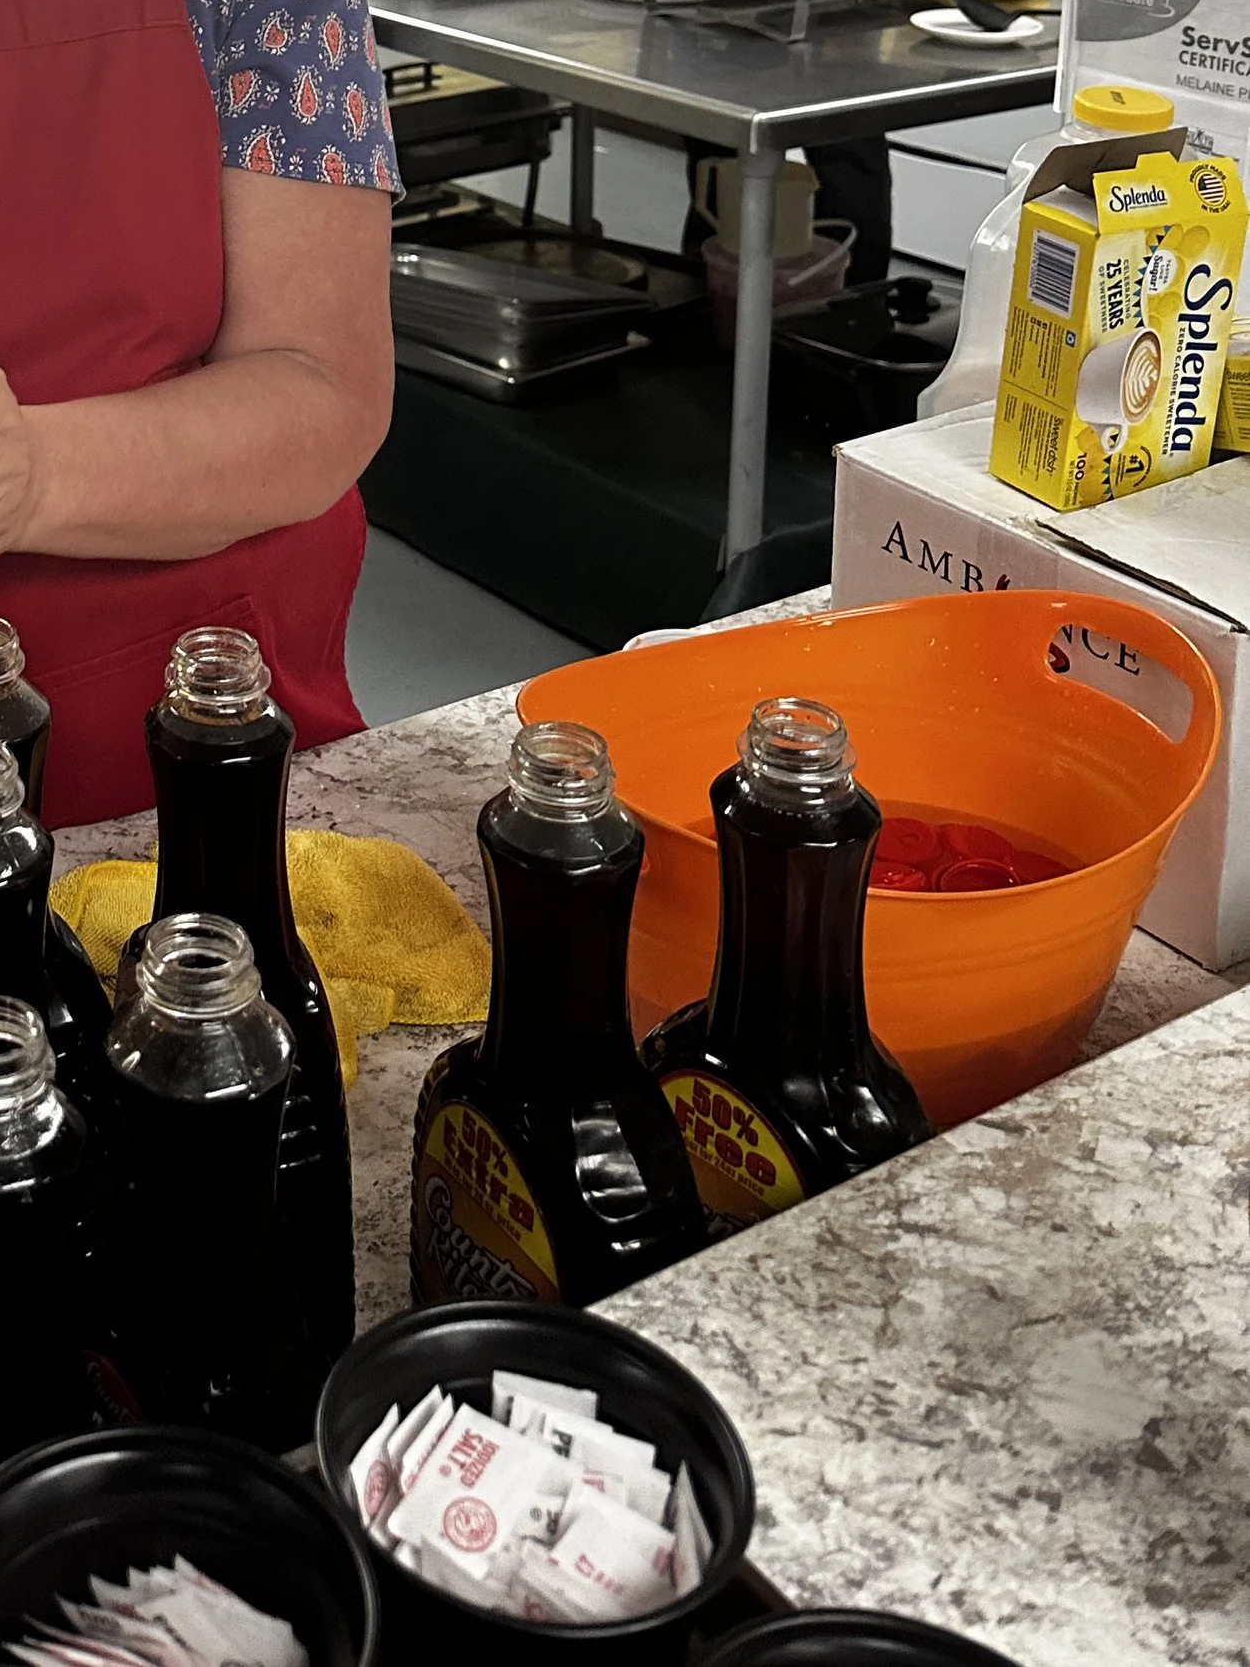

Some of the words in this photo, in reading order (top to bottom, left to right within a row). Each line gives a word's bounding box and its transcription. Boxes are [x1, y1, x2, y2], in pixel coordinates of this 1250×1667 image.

[1175, 74, 1235, 97] MELAINE
[1109, 185, 1167, 212] Splenda
[1106, 258, 1122, 279] 25
[1123, 259, 1132, 319] CELEBRATING
[1149, 254, 1164, 292] Sugar!
[1107, 280, 1124, 330] YEARS
[1171, 264, 1233, 452] Splenda
[1177, 327, 1186, 353] ZERO
[1170, 355, 1182, 399] CALORIE
[1161, 399, 1176, 456] SWEETENER
[1075, 452, 1087, 481] 100
[693, 1078, 759, 1147] 50%
[461, 1109, 509, 1179] 50%
[674, 1095, 777, 1187] Free
[443, 1114, 535, 1234] Extra
[450, 1428, 484, 1470] SALT
